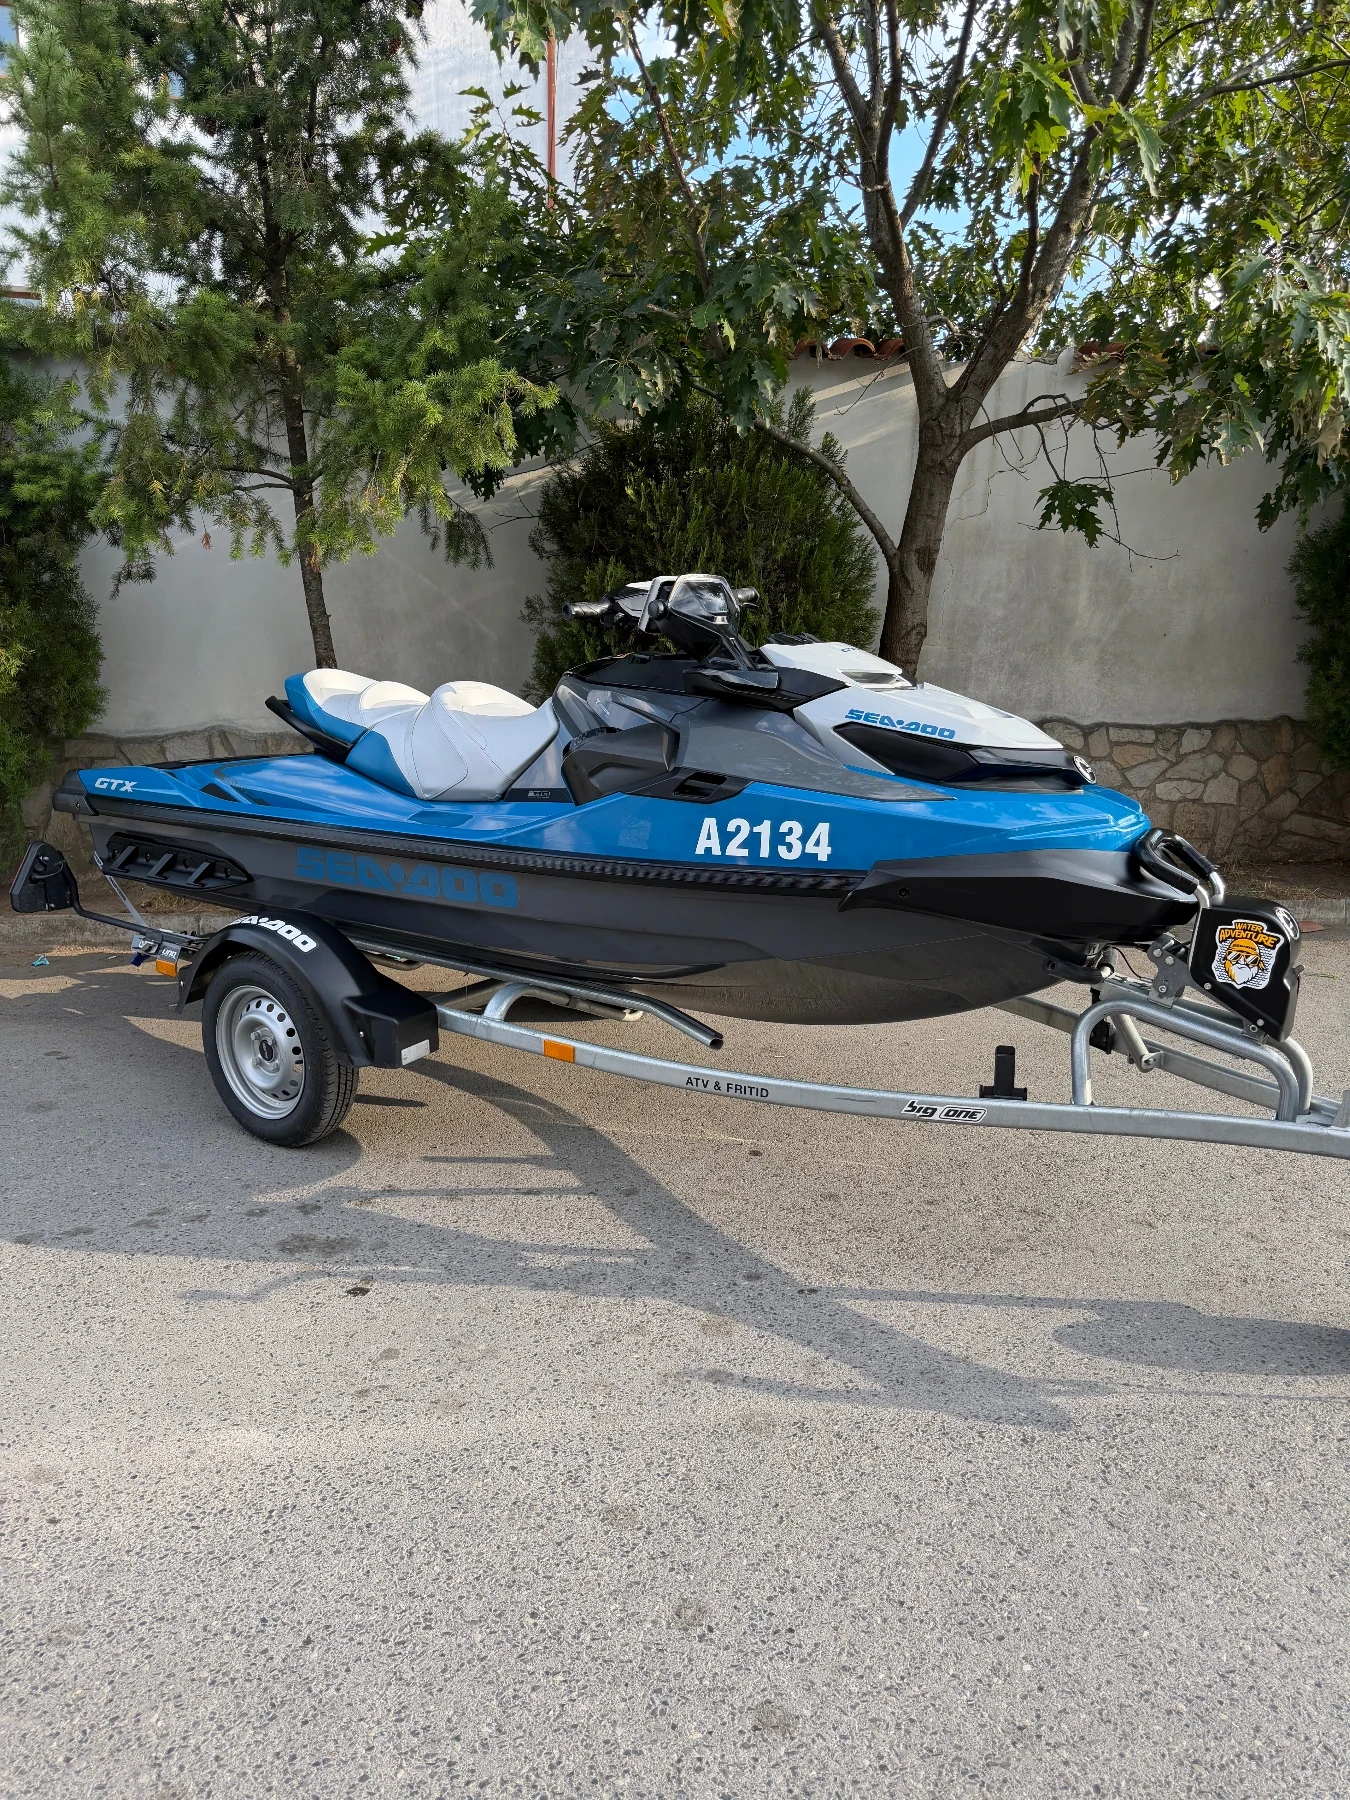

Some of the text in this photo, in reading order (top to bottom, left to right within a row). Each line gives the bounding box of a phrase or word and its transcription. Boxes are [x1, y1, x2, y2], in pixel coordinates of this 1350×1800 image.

[94, 778, 138, 793] GTX
[695, 817, 832, 862] A2134
[1235, 922, 1262, 933] WATER
[1219, 929, 1277, 948] ADVENTURE
[685, 1076, 769, 1098] ATV & FRITID
